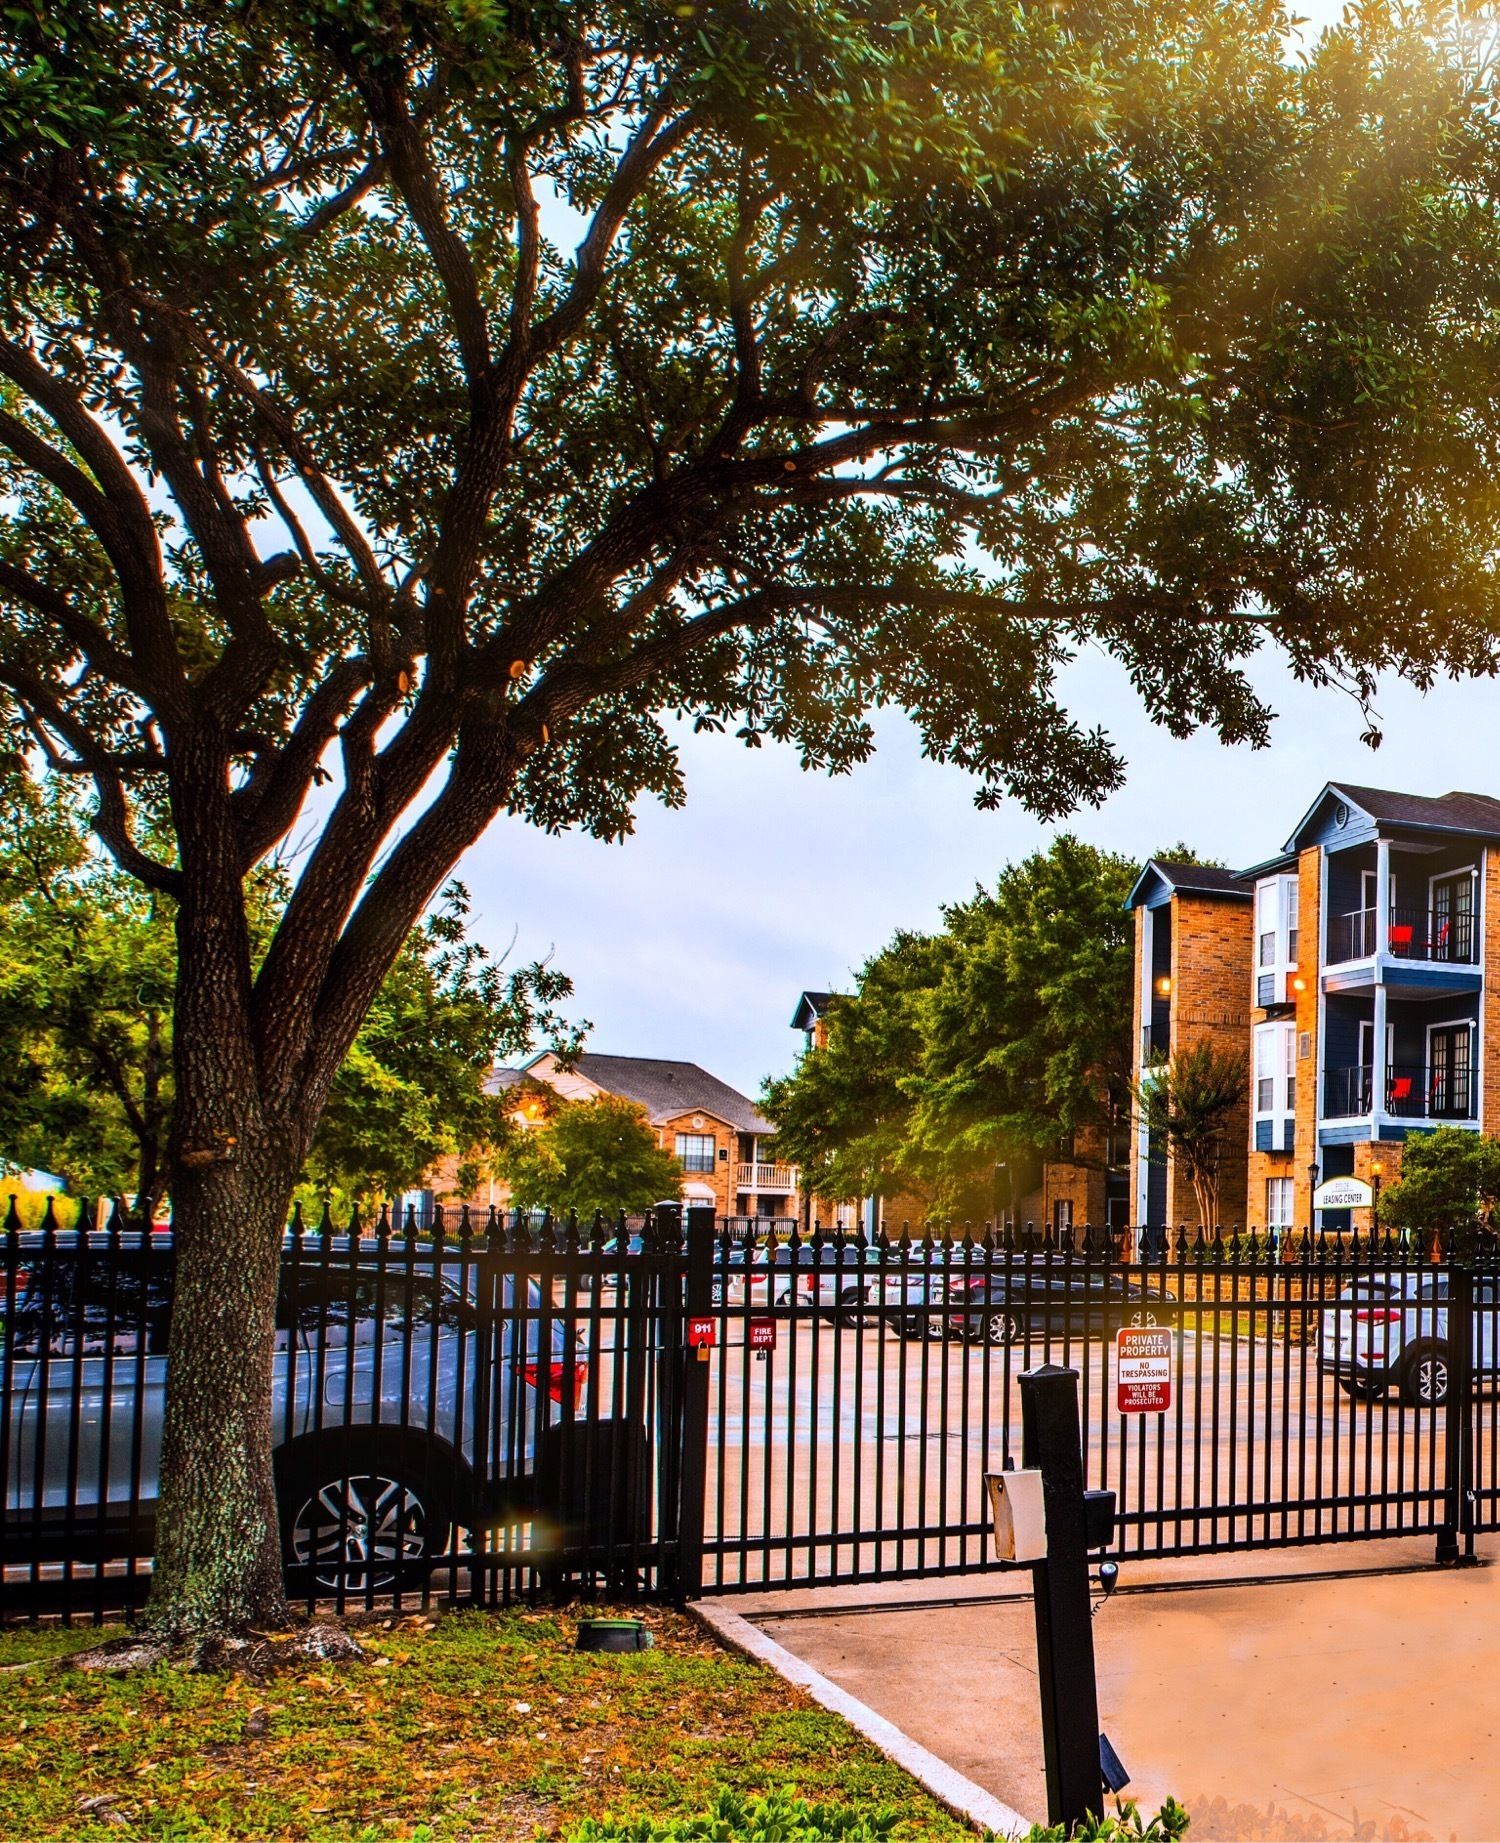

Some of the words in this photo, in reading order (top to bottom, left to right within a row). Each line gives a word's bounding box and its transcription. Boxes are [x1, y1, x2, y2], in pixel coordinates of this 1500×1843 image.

[1323, 1194, 1343, 1204] LEASING
[1344, 1193, 1363, 1203] CENTER
[694, 1323, 711, 1333] 911
[754, 1327, 772, 1335] FIRE
[753, 1335, 773, 1343] DEPT
[1126, 1335, 1163, 1345] PRIVATE
[1120, 1346, 1168, 1356] PROPERTY
[1139, 1362, 1150, 1370] NO
[1121, 1370, 1167, 1378] TRESPASSING
[1127, 1384, 1161, 1392] VIOLATORS
